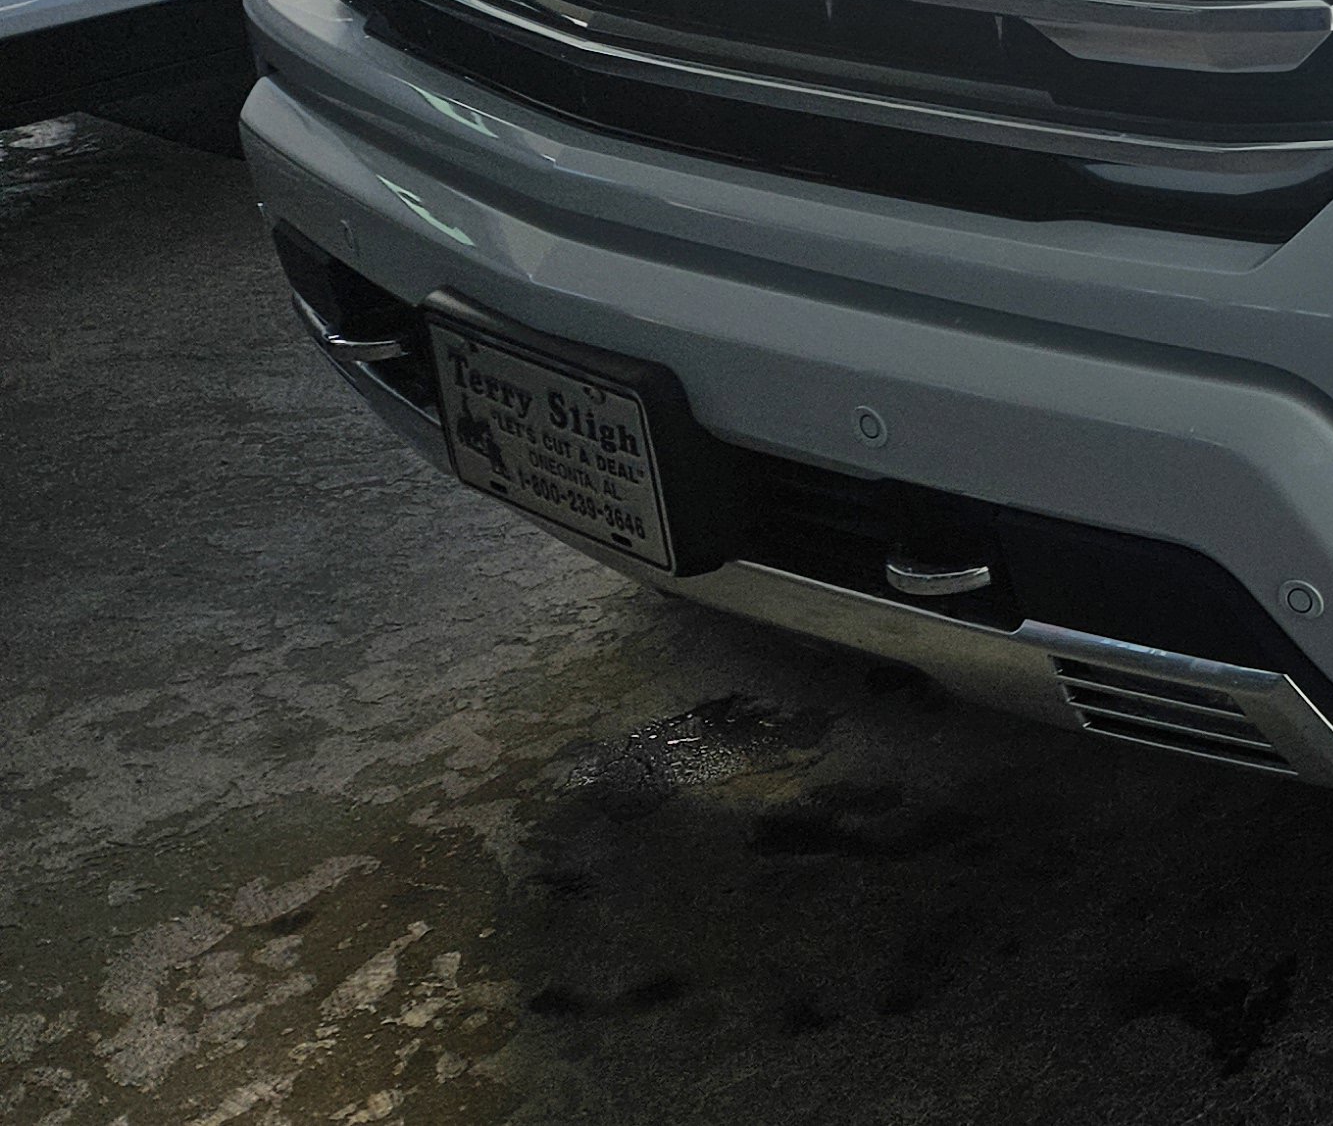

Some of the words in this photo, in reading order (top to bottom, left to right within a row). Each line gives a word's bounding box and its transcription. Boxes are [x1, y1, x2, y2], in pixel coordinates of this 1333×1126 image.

[449, 350, 533, 419] Terry
[548, 389, 641, 457] Sligh
[542, 434, 572, 459] CUT
[579, 448, 591, 466] A
